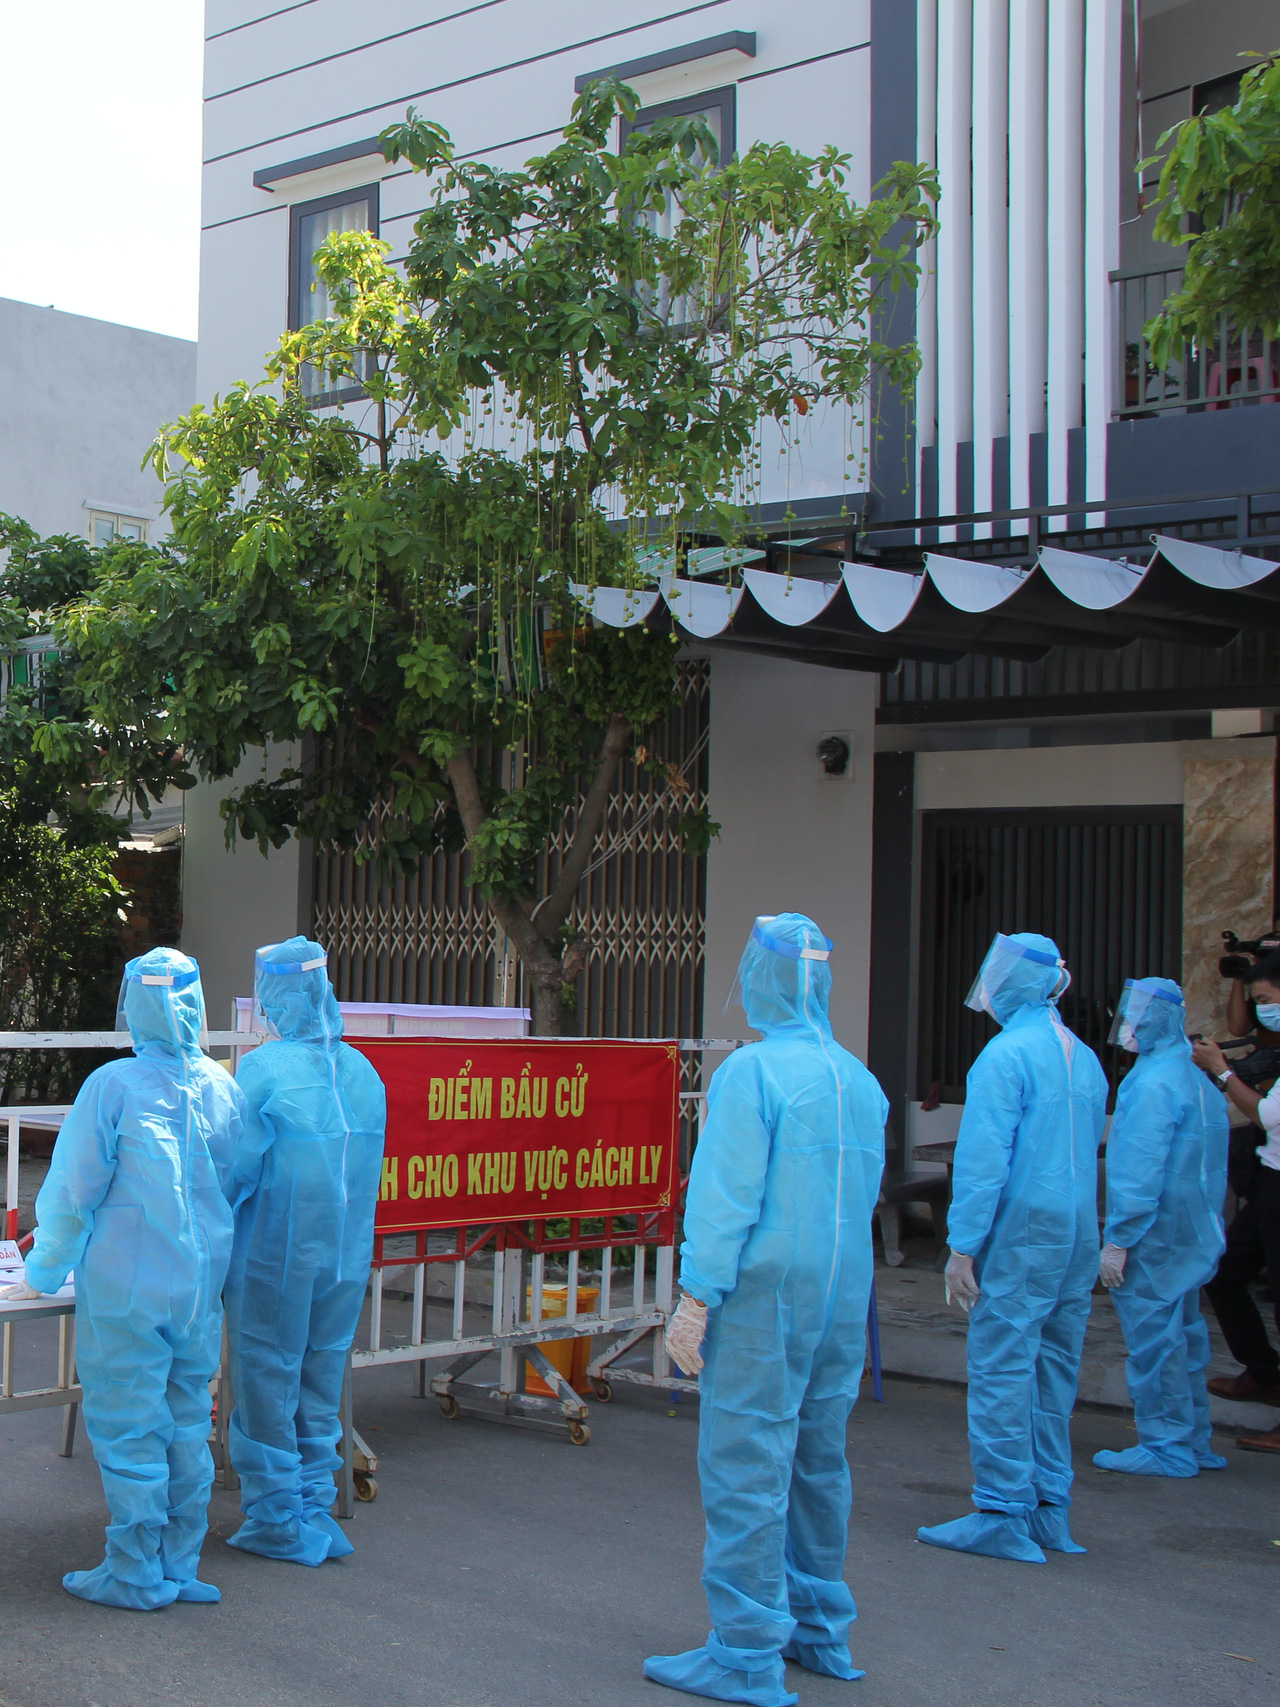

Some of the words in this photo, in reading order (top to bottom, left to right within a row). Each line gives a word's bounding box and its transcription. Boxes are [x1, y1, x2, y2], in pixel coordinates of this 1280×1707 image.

[428, 1059, 493, 1121] ĐIỂM
[500, 1062, 548, 1119] BẦU
[555, 1063, 589, 1118] CỬ
[407, 1154, 459, 1200] CHO
[467, 1152, 517, 1195] KHU
[524, 1146, 568, 1200] VỰC
[575, 1139, 634, 1189] CÁCH
[639, 1145, 663, 1184] LY
